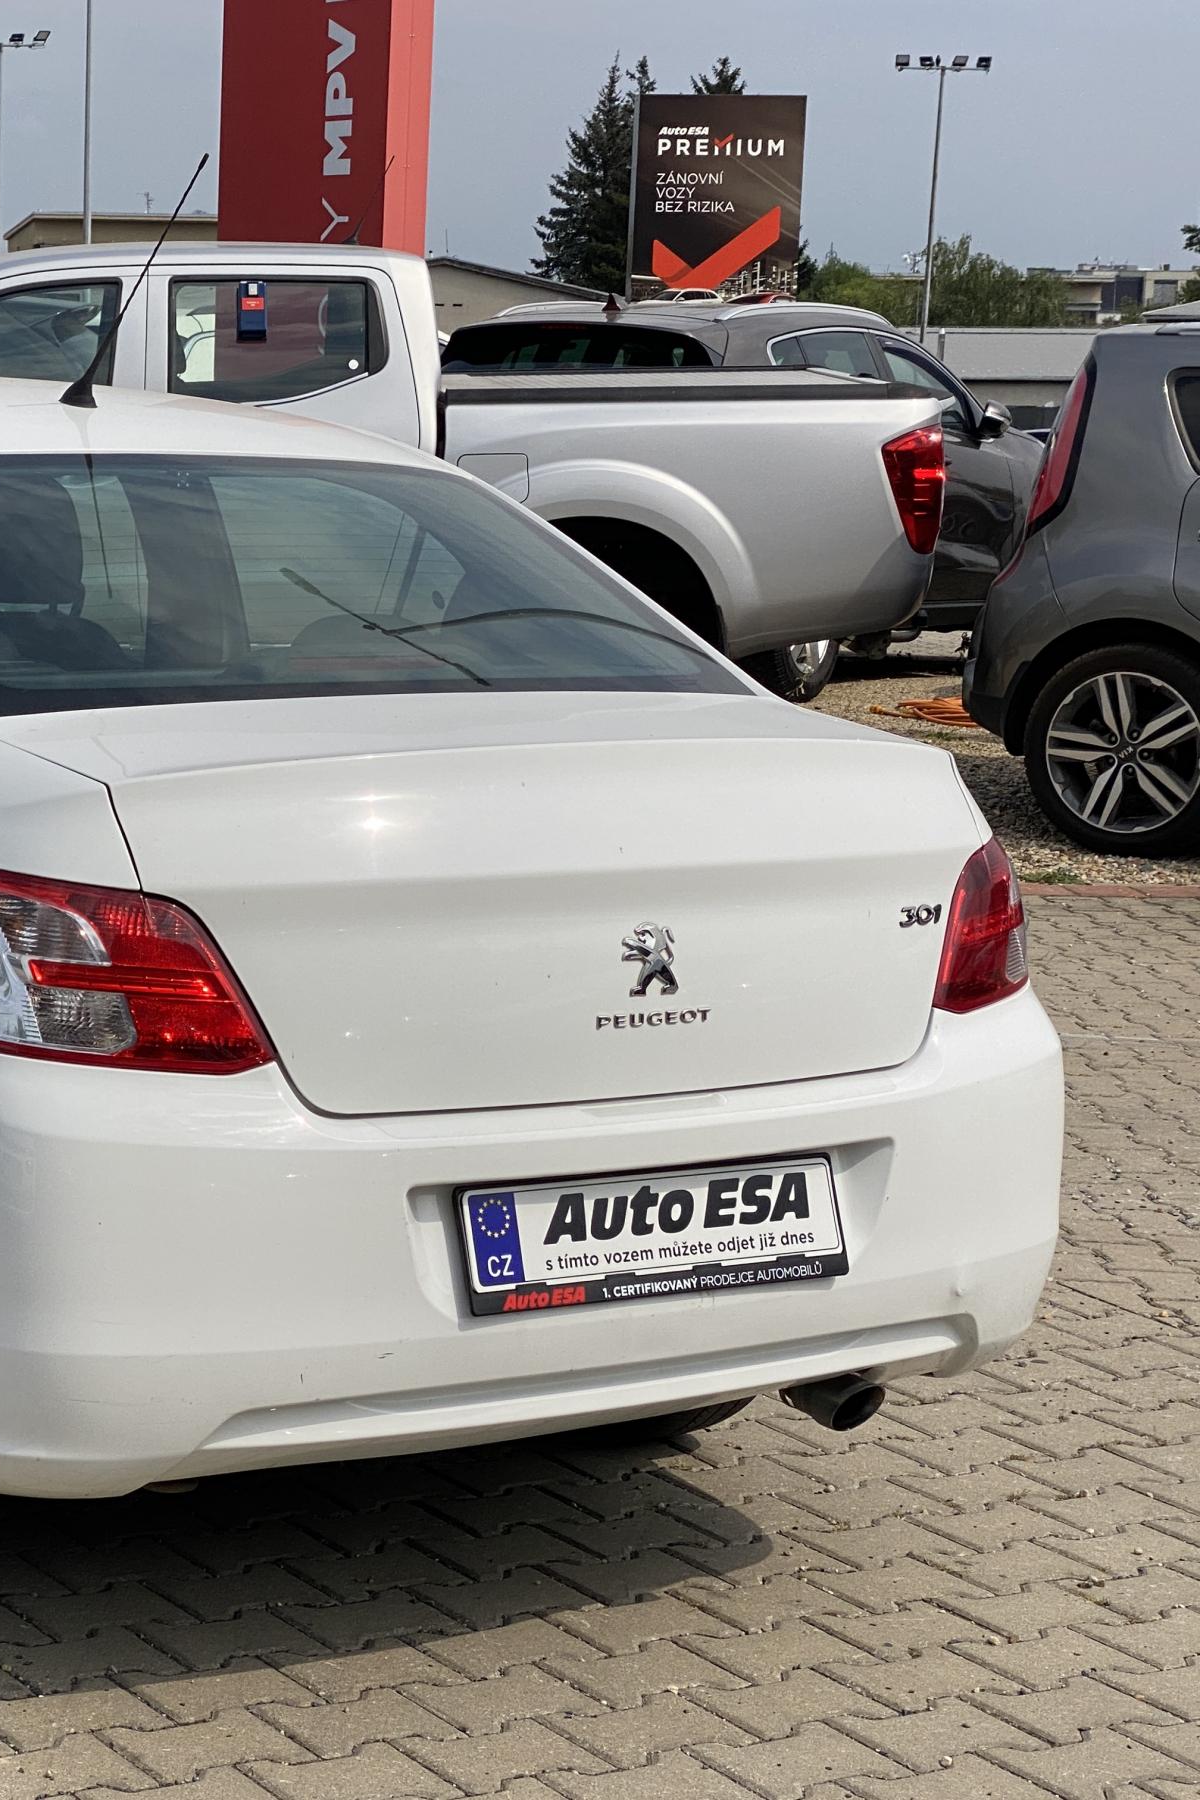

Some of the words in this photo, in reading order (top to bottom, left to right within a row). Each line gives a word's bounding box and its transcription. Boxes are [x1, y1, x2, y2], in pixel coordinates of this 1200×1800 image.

[323, 18, 356, 176] MPV
[658, 126, 688, 136] Auto
[687, 126, 710, 136] ESA
[657, 133, 785, 156] PREMIUM
[655, 170, 725, 185] ZÁNOVNÍ
[655, 187, 696, 199] VOZY
[655, 201, 684, 213] BEZ
[687, 201, 735, 213] RIZIKA
[899, 903, 942, 928] 301
[596, 1007, 711, 1030] PEUGEOT
[543, 1185, 695, 1245] Auto
[703, 1172, 810, 1229] ESA
[545, 1259, 554, 1271] s
[557, 1253, 600, 1270] tímto
[604, 1247, 654, 1264] vozem
[658, 1240, 713, 1260] můžete
[717, 1235, 756, 1254] odjet
[758, 1232, 777, 1251] již
[780, 1231, 815, 1247] dnes
[487, 1254, 515, 1277] CZ
[602, 1287, 612, 1299] 1.
[613, 1275, 698, 1297] CERTIFIKOVANÝ
[700, 1270, 755, 1288] PRODEJCE
[757, 1260, 824, 1281] AUTOMOBILŮ
[503, 1291, 551, 1312] Auto
[551, 1286, 586, 1306] ESA
